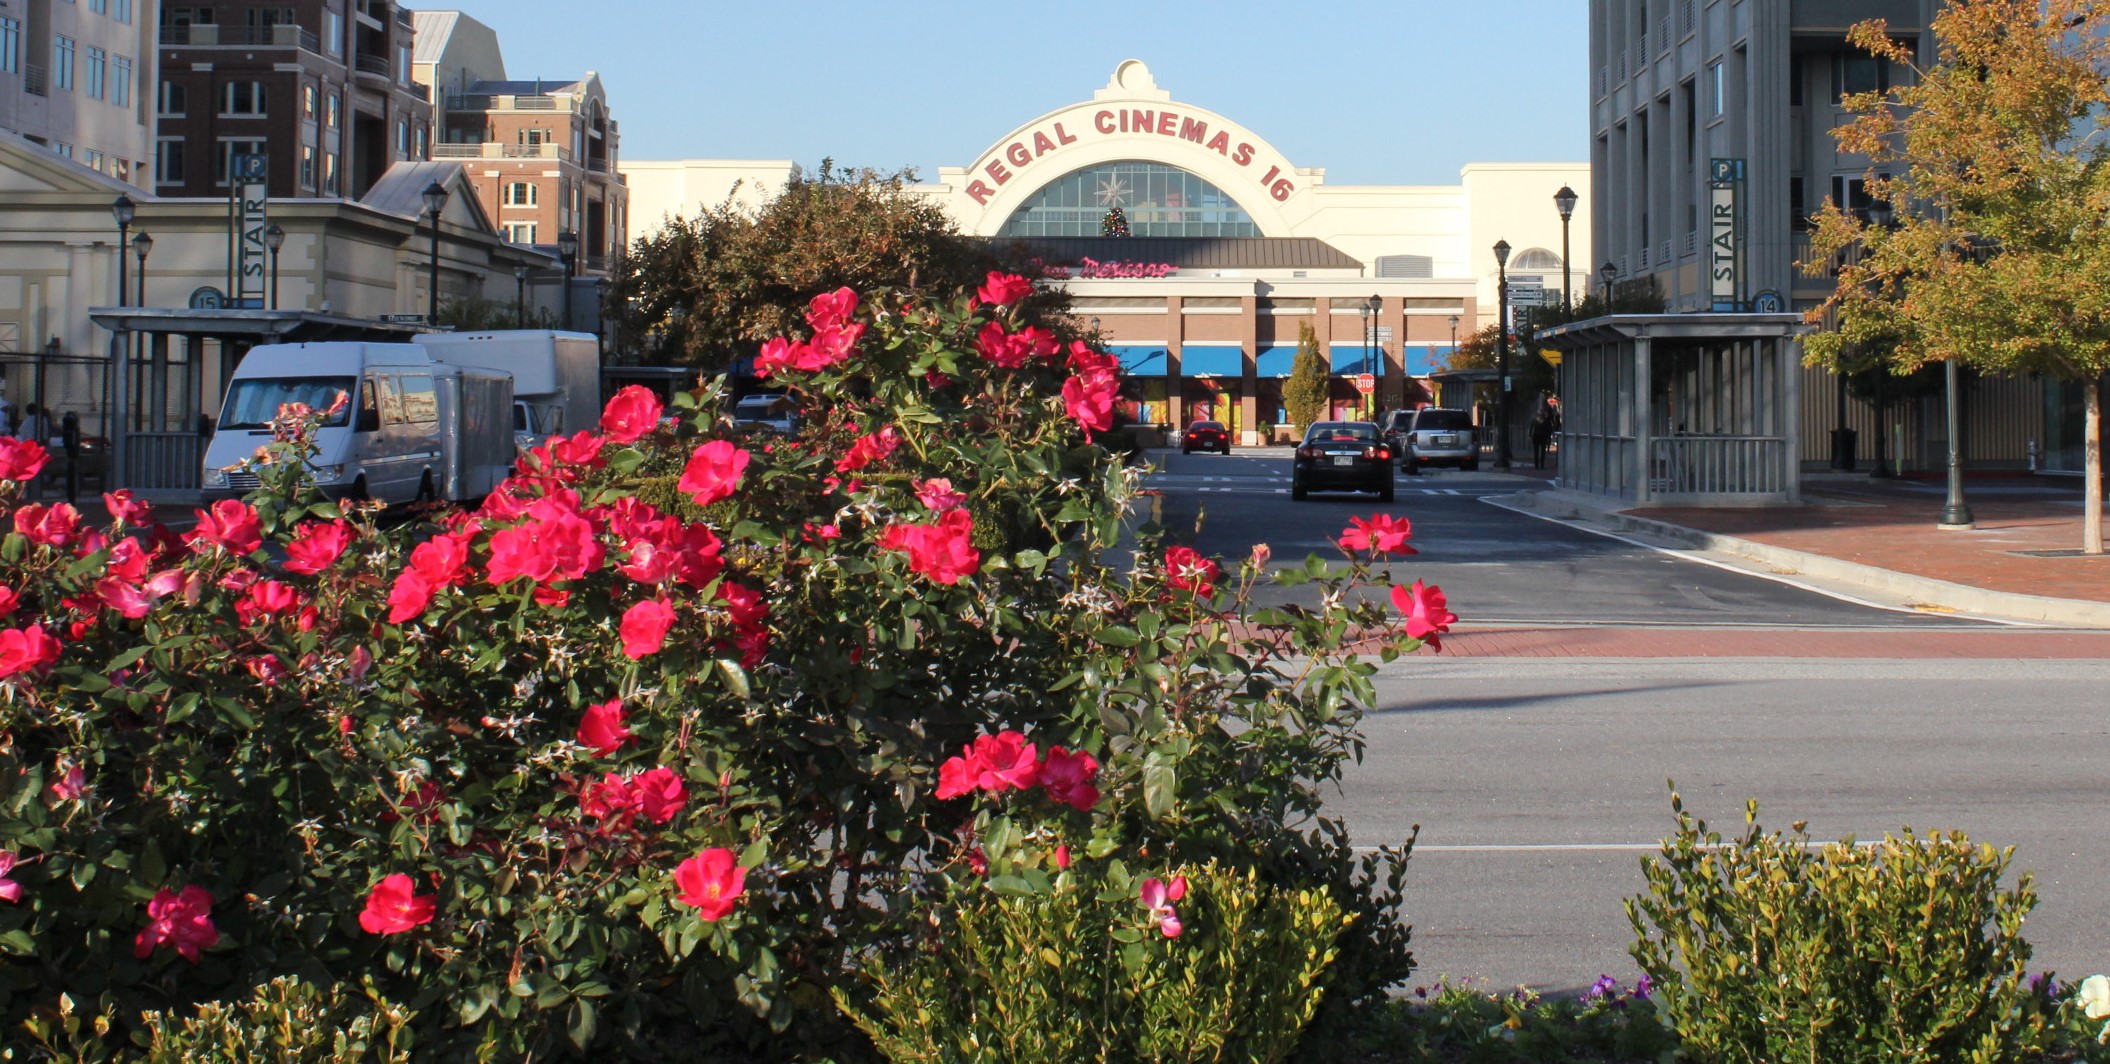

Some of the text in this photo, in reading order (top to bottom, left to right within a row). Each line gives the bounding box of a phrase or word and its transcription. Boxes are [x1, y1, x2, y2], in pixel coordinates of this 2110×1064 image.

[966, 109, 1294, 206] REGAL CINEMAS 16
[250, 159, 260, 173] P
[1719, 163, 1728, 178] P
[244, 200, 264, 277] STAIR
[1714, 204, 1733, 281] STAIR
[1079, 256, 1179, 279] Mexicano
[200, 297, 215, 309] 15
[1760, 299, 1776, 313] 14
[1357, 379, 1374, 389] STOP
